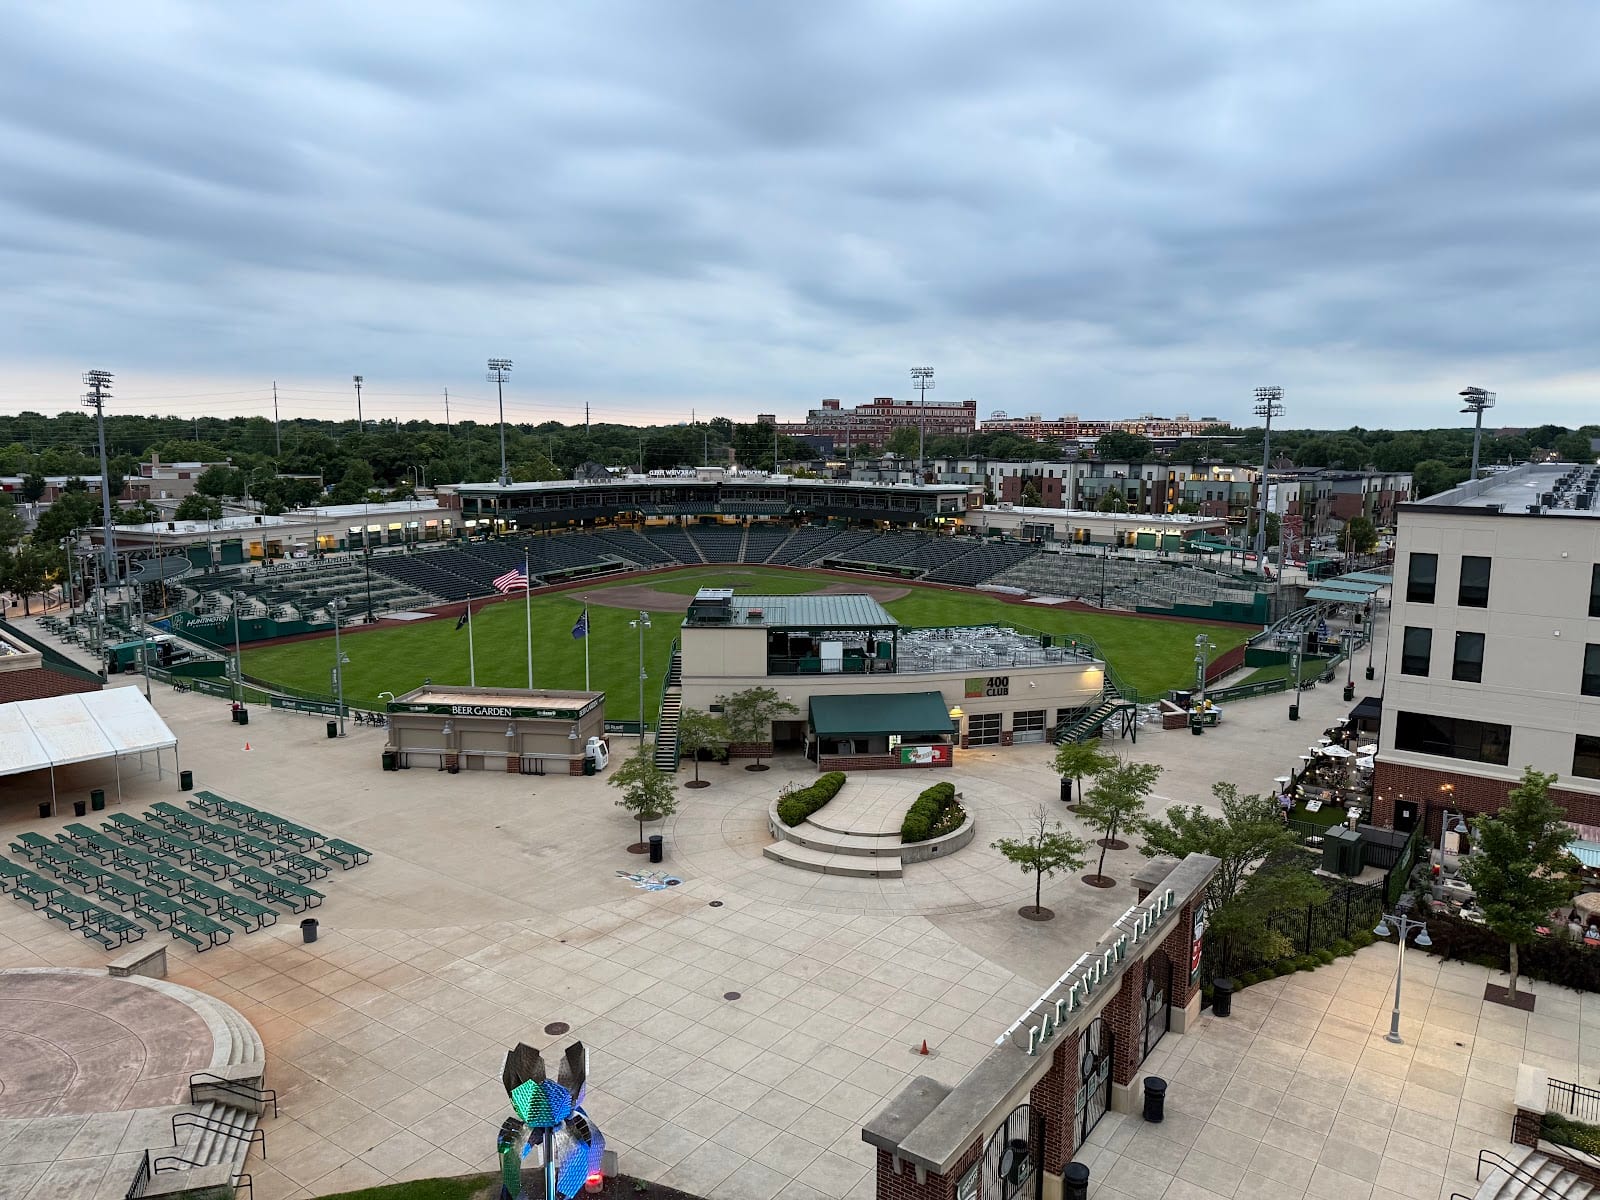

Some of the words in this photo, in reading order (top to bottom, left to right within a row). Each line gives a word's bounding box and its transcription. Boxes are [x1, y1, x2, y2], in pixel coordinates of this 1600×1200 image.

[186, 614, 230, 627] HUNTINGTON
[986, 676, 1009, 688] 400
[986, 687, 1009, 697] CLUB
[452, 705, 473, 715] BEER
[474, 706, 512, 717] GARDEN
